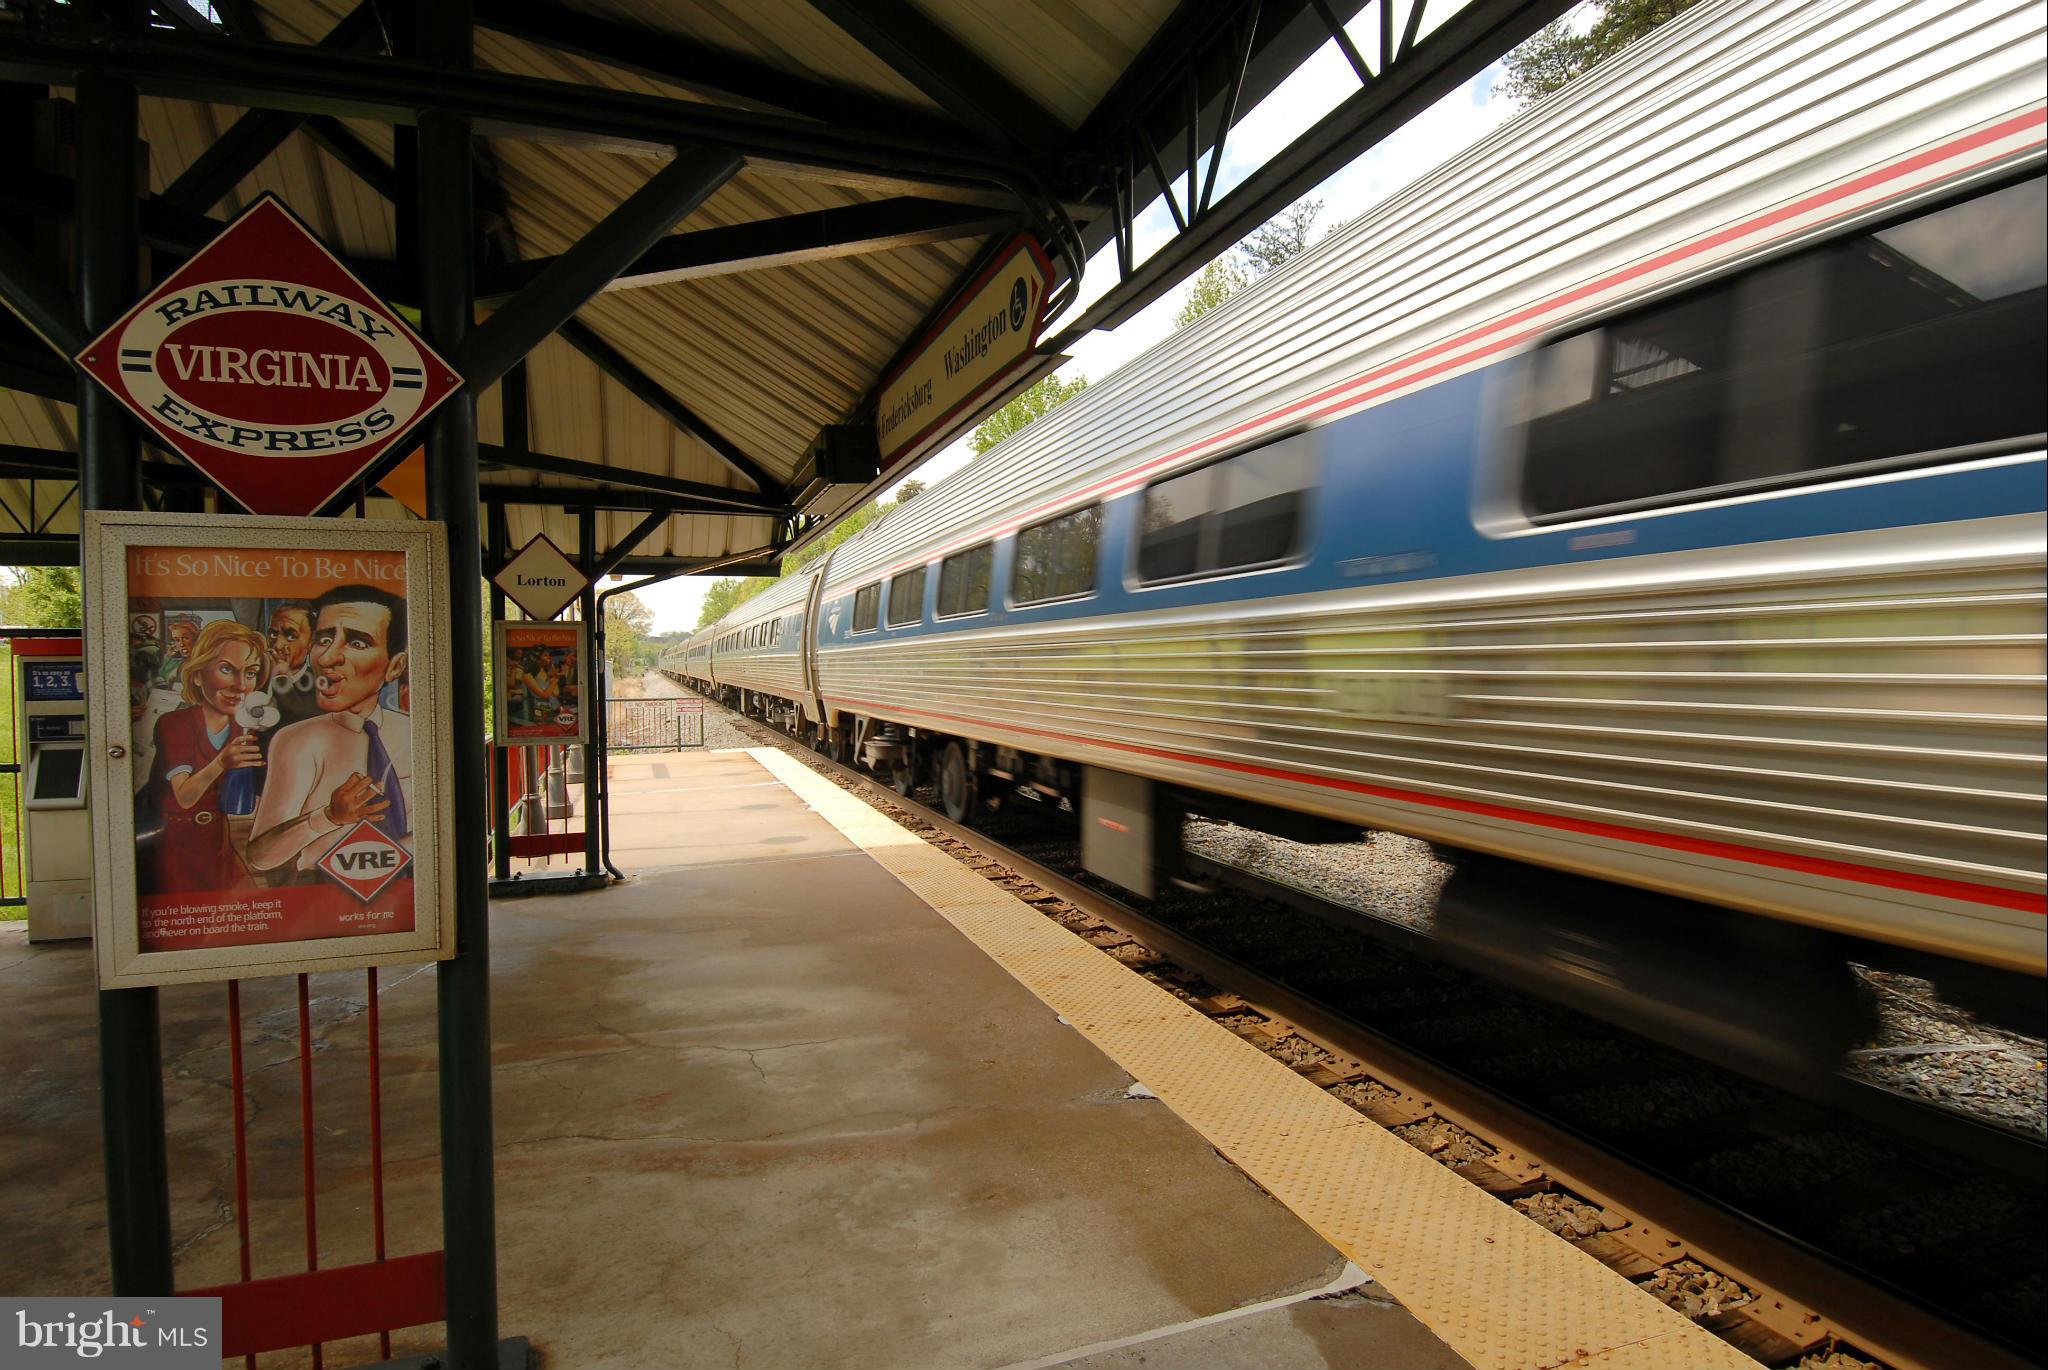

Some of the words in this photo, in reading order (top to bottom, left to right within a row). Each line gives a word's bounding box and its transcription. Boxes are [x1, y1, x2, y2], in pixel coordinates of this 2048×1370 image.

[155, 285, 395, 341] RAILWAY
[944, 308, 1006, 380] Washington
[164, 344, 382, 392] VIRGINIA
[881, 378, 932, 438] Fredericksburg
[152, 394, 396, 451] EXPRESS
[134, 554, 170, 576] It's
[176, 554, 209, 577] So
[213, 555, 271, 578] Nice
[275, 556, 309, 578] To
[314, 557, 347, 579] Be
[352, 558, 407, 581] Nice
[517, 574, 566, 588] Lorton
[32, 676, 44, 689] 1,
[46, 676, 58, 688] 2,
[60, 676, 71, 687] 3.
[336, 850, 395, 871] VRE
[142, 919, 152, 928] to
[154, 917, 169, 927] the
[171, 915, 195, 926] north
[197, 914, 215, 924] end
[216, 913, 226, 922] of
[227, 912, 242, 922] the
[243, 910, 283, 923] platform,
[150, 905, 179, 919] you're
[180, 903, 216, 915] blowing
[218, 901, 250, 913] smoke,
[252, 900, 274, 912] keep
[275, 900, 281, 908] it
[339, 911, 364, 922] works
[366, 911, 382, 920] for
[383, 911, 395, 919] me
[142, 929, 160, 938] and
[163, 928, 187, 937] never
[189, 927, 201, 935] on
[203, 924, 229, 935] board
[230, 923, 246, 932] the
[246, 921, 270, 931] train.
